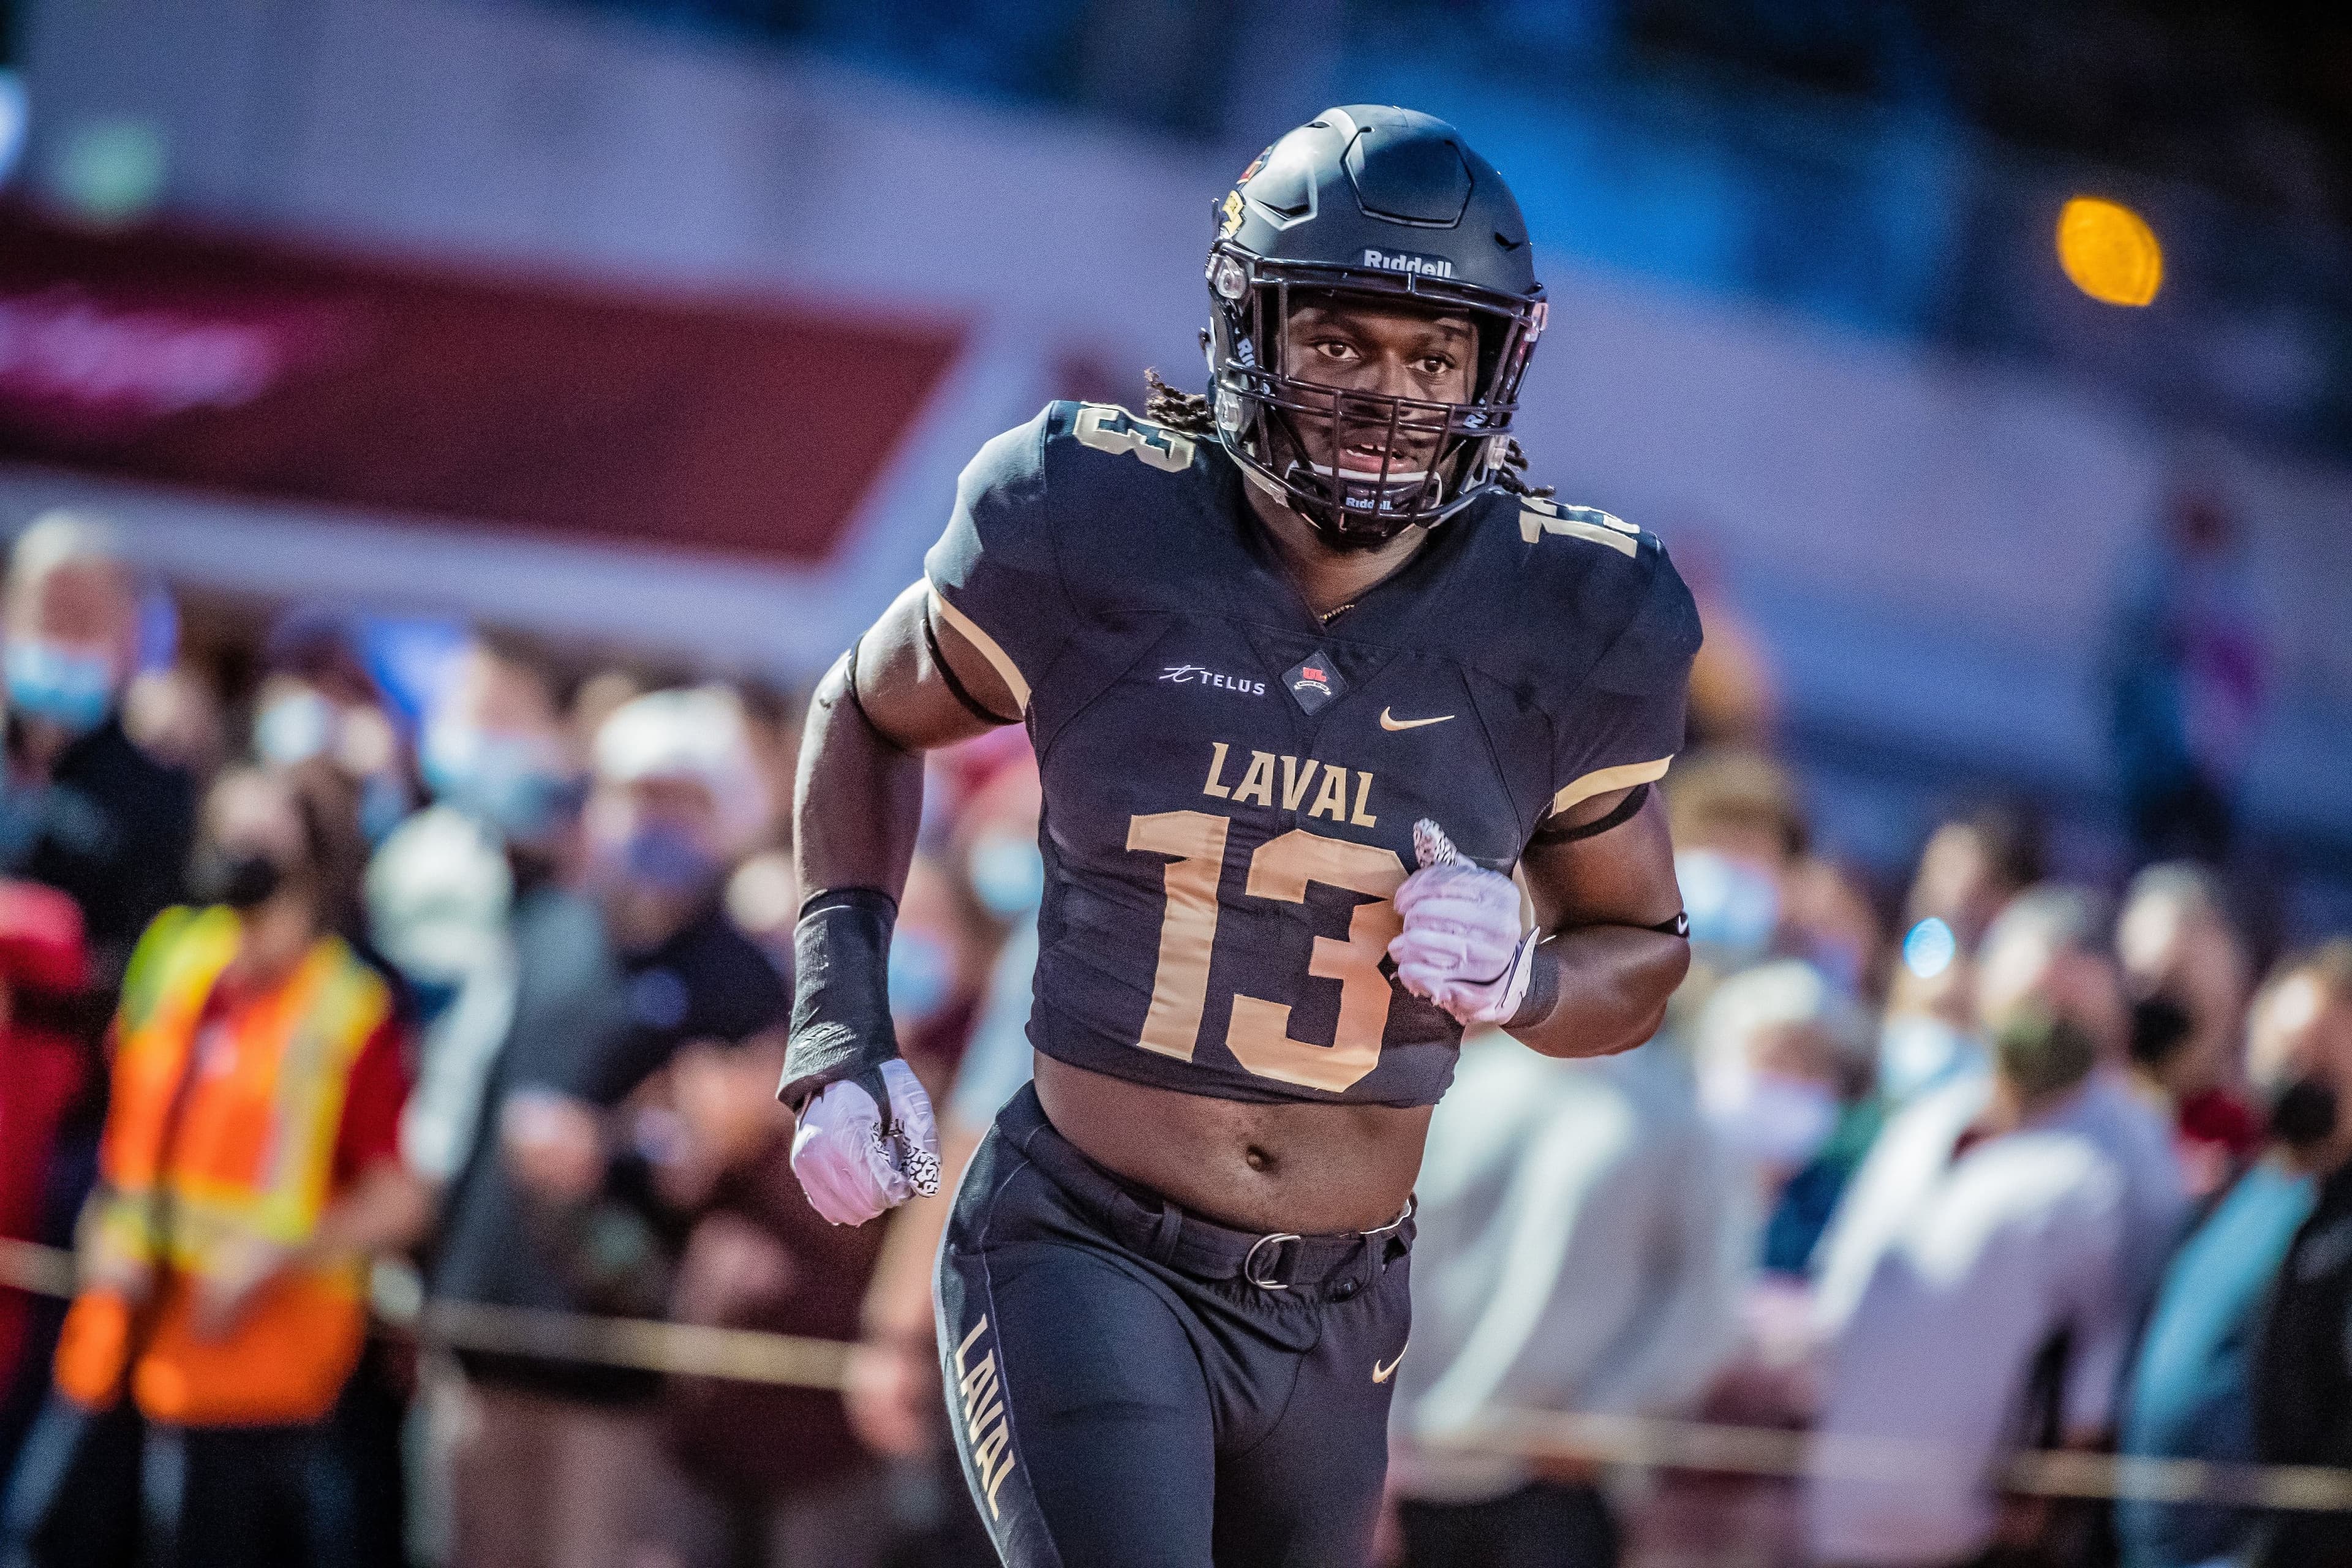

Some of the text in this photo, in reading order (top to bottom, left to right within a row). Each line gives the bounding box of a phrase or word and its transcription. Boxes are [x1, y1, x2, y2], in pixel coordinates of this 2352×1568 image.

[1363, 249, 1452, 279] Riddell
[1200, 670, 1266, 696] TELUS
[1202, 742, 1378, 829] LAVAL
[1126, 810, 1410, 1093] 13
[955, 1313, 1016, 1521] LAVAL
